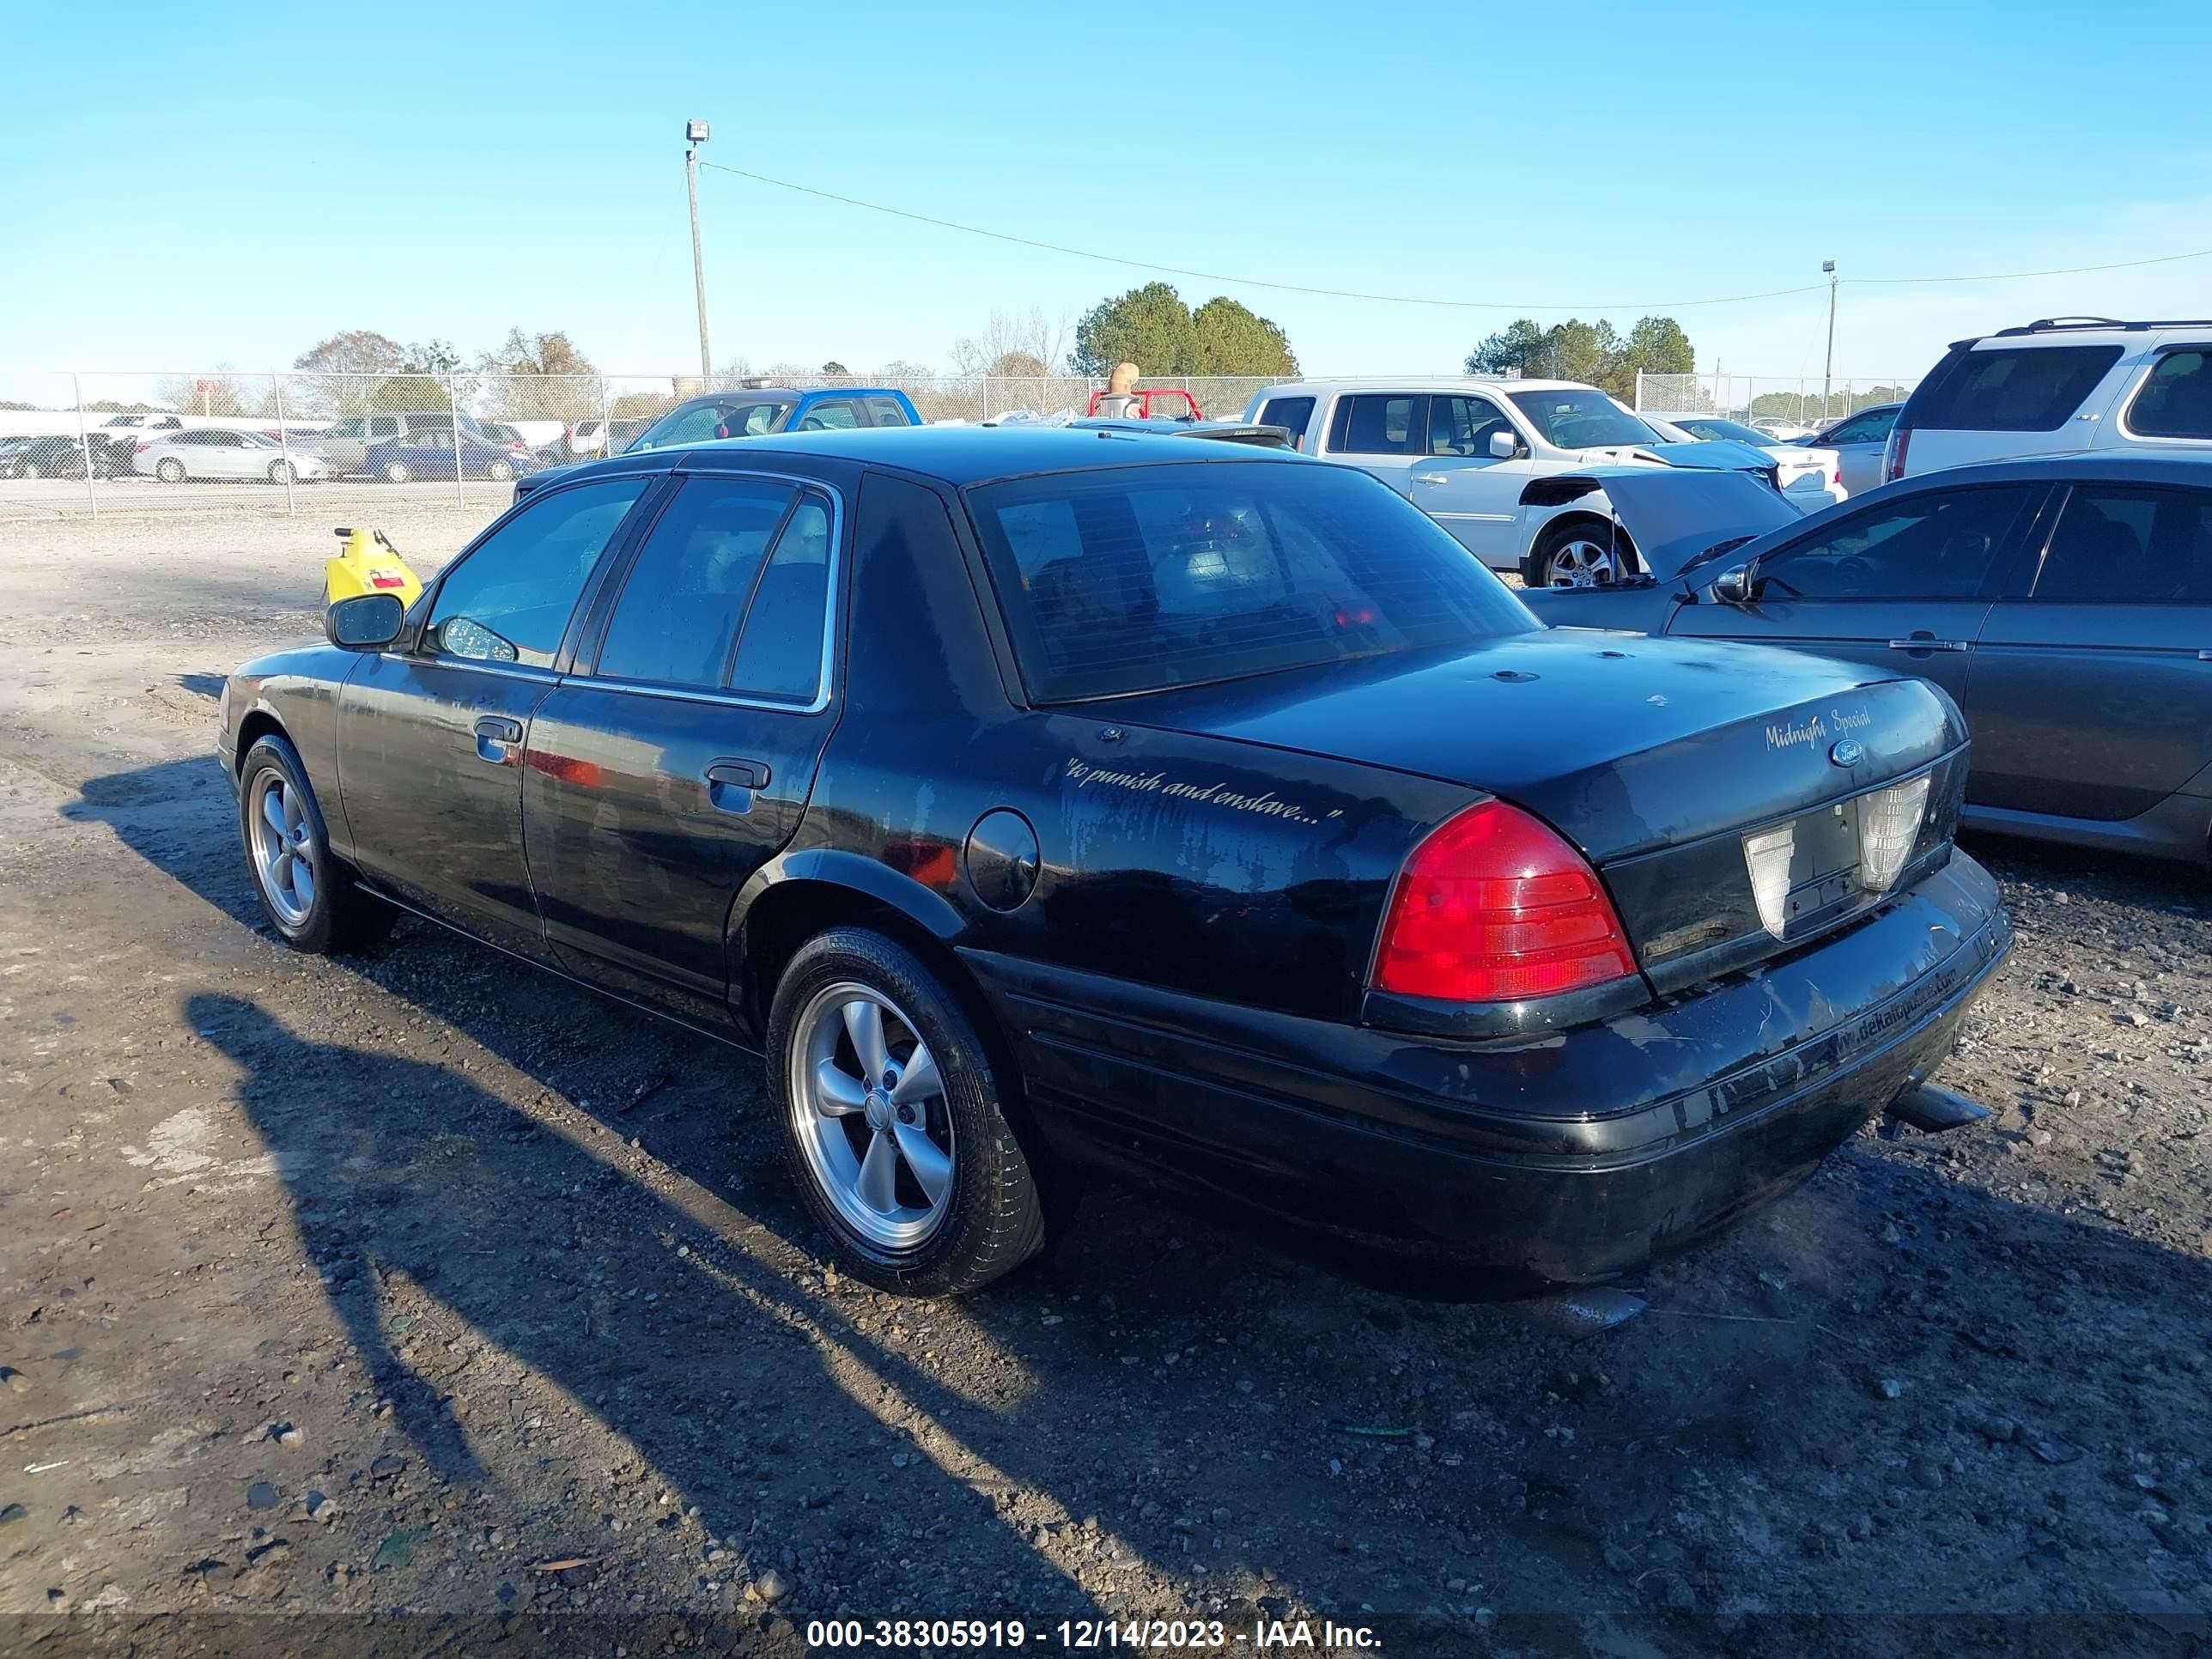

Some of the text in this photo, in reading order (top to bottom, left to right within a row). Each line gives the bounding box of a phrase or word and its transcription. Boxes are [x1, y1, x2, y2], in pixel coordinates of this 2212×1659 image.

[1765, 706, 1872, 751] Midnight Special
[1841, 744, 1857, 761] Ford
[1079, 769, 1161, 790] punish
[1161, 782, 1226, 801] and
